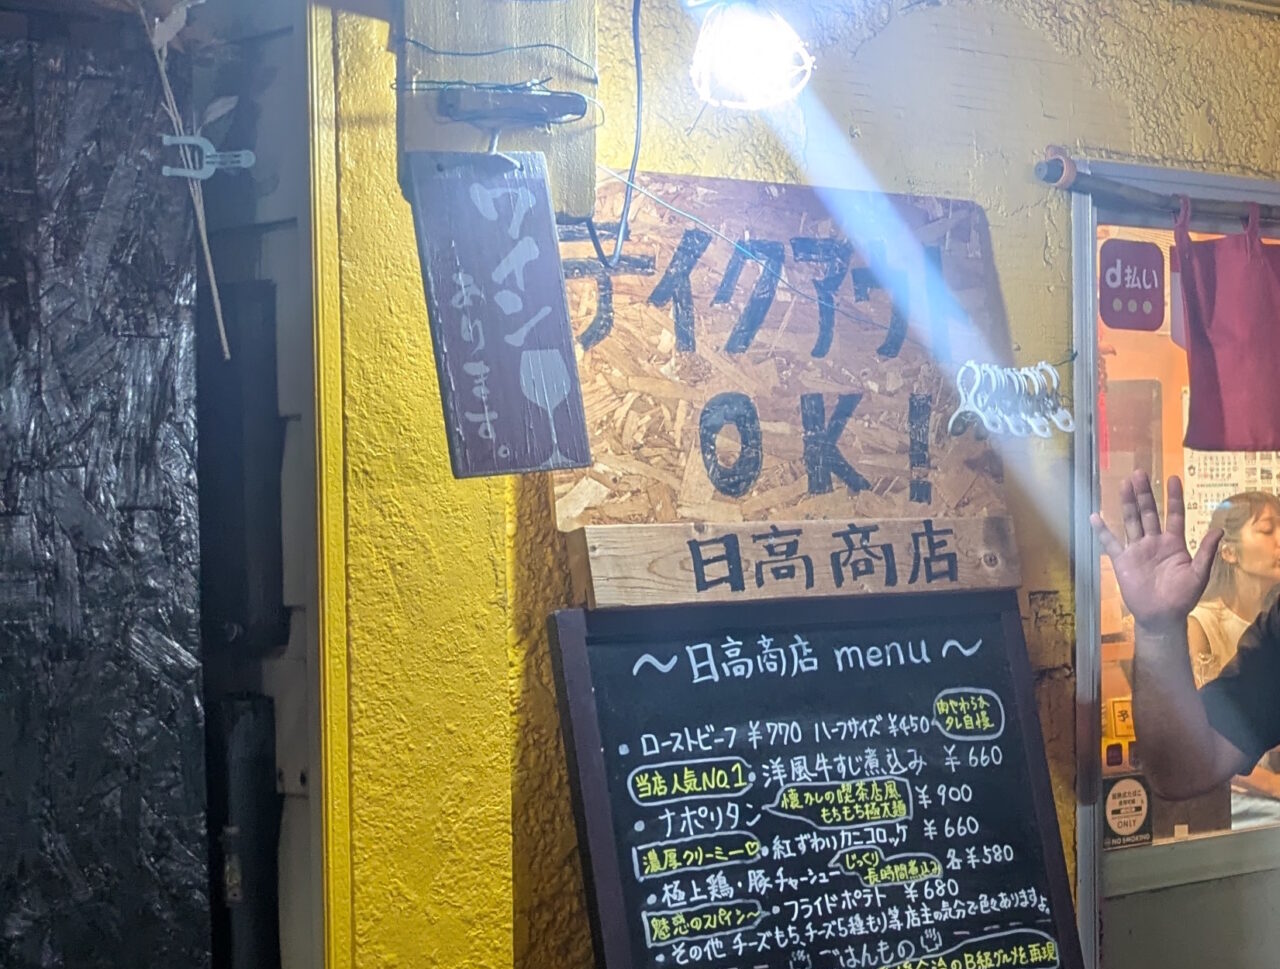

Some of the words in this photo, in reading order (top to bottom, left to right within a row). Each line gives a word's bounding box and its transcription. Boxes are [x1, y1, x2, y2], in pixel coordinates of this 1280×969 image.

[469, 182, 552, 347] ワイン
[1105, 258, 1158, 290] d払い
[699, 390, 932, 504] OK!
[686, 518, 960, 594] 日高商店
[685, 633, 820, 685] 日高商店
[835, 638, 932, 672] menu
[641, 724, 738, 757] ローストビーフ
[747, 719, 803, 750] ¥770
[815, 713, 884, 744] ハーフサイズ
[944, 710, 996, 733] タレ自慢
[761, 746, 928, 788] 洋風牛すじ煮込み
[942, 743, 1004, 773] ¥660
[657, 801, 762, 838] ナポリタン
[914, 783, 974, 809] ¥900
[780, 779, 902, 811] 懐かしの喫茶店風
[922, 815, 980, 841] ¥660
[844, 850, 880, 870] じっくり
[863, 858, 942, 886] 長時間煮込み
[783, 887, 888, 922] フライドポテト
